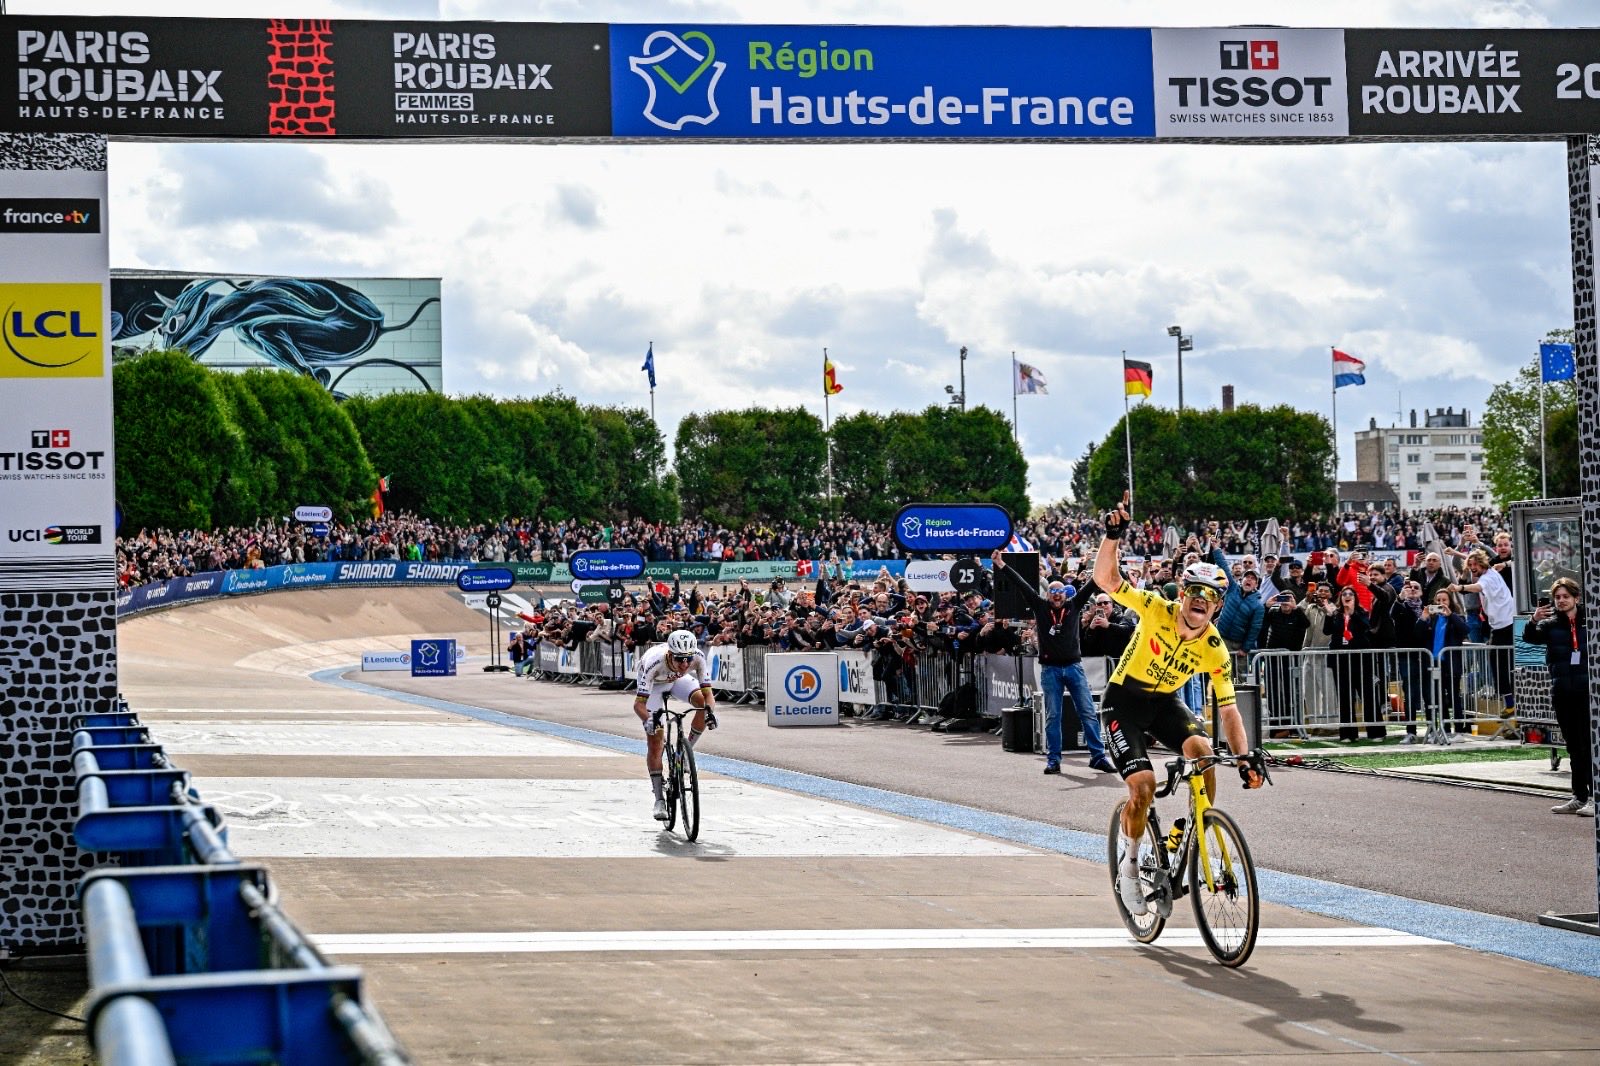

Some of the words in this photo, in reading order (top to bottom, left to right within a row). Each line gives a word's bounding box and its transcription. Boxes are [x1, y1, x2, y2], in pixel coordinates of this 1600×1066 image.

[18, 30, 150, 64] PARIS
[393, 32, 496, 60] PARIS
[748, 40, 874, 78] Région
[1374, 44, 1520, 78] ARRIVÉE
[18, 67, 224, 102] ROUBAIX
[394, 62, 554, 90] ROUBAIX
[1556, 63, 1600, 100] 20
[398, 94, 472, 110] FEMMES
[1168, 76, 1332, 107] TISSOT
[1362, 84, 1522, 114] ROUBAIX
[19, 106, 224, 119] HAUTS-DE-FRANCE
[750, 86, 1134, 126] Hauts-de-France
[395, 114, 555, 124] HAUTS-DE-FRANCE
[1170, 114, 1207, 124] SWISS
[1210, 113, 1266, 124] WATCHES
[1270, 113, 1305, 123] SINCE
[1308, 112, 1334, 122] 1853
[12, 310, 97, 338] LCL
[0, 451, 104, 470] TISSOT
[925, 528, 1005, 538] Hauts-de-France
[926, 519, 951, 527] Région
[8, 530, 40, 542] UCI
[339, 564, 396, 579] SHIMANO
[959, 569, 975, 583] 25
[610, 589, 622, 598] 50
[1150, 659, 1179, 680] lease
[1164, 652, 1194, 675] VISMA
[775, 705, 832, 716] E.Leclerc
[1113, 729, 1130, 754] VISMA
